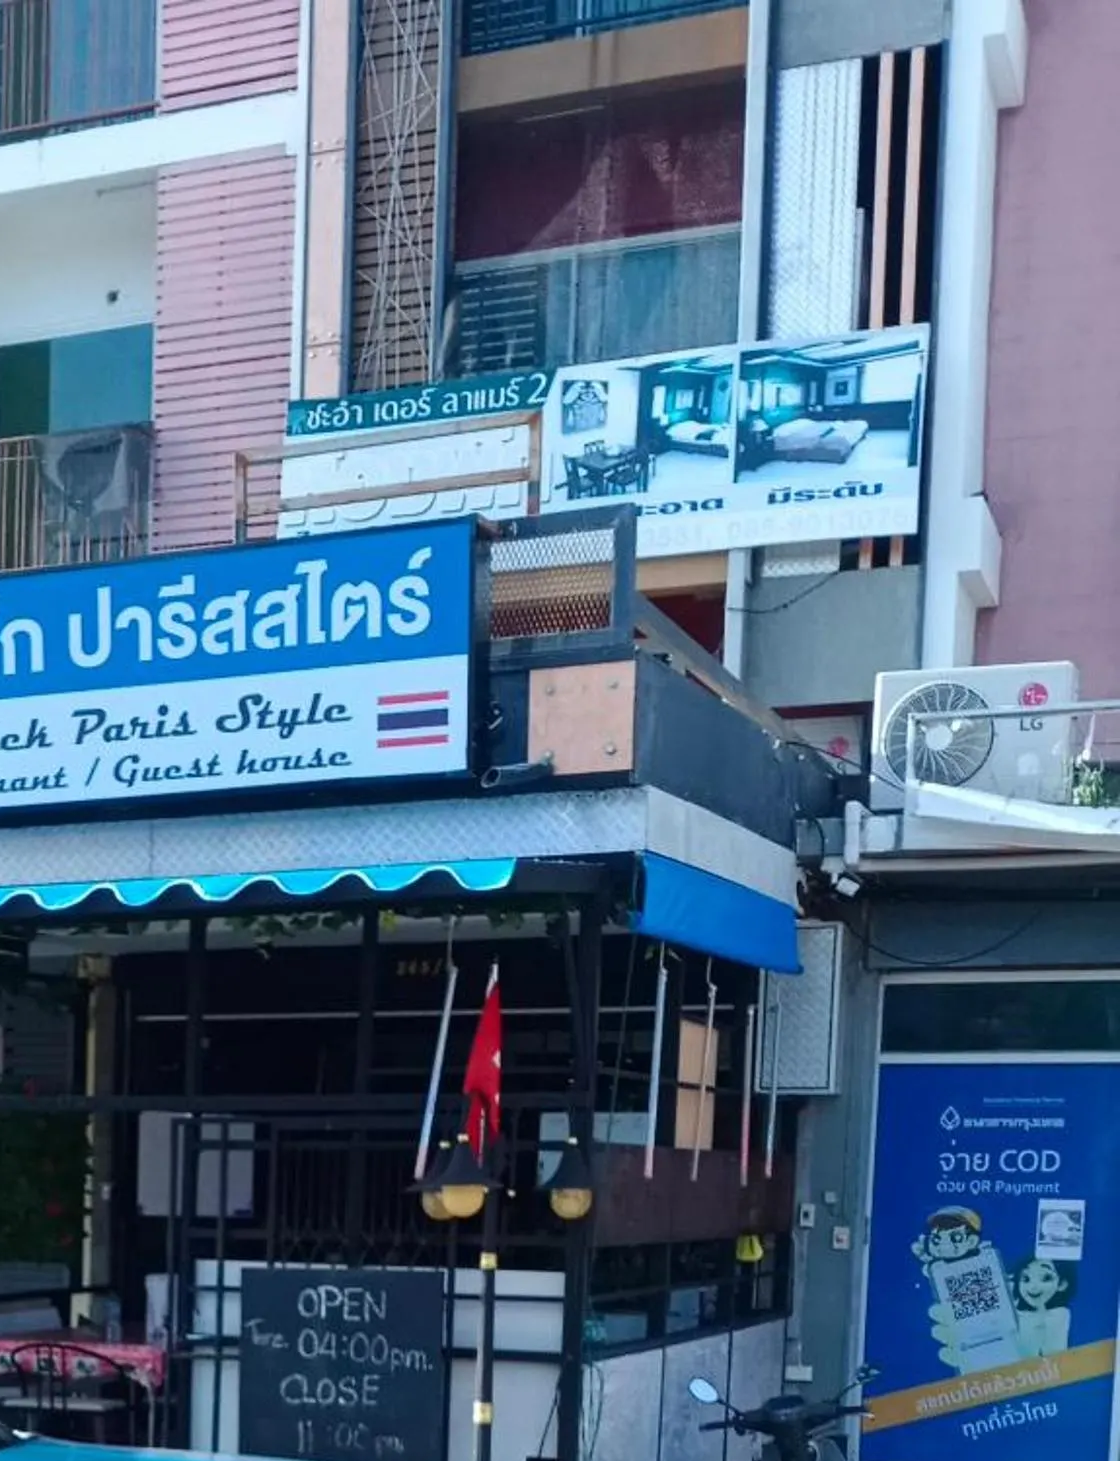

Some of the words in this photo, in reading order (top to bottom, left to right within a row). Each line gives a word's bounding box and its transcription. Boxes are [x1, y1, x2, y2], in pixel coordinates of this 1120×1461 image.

[305, 400, 363, 429] ชะอำ
[373, 387, 438, 421] เดอร์
[441, 376, 525, 414] ลาแมร์
[527, 372, 548, 405] 2
[67, 546, 434, 668] ปารีสสไตร์
[71, 704, 198, 748] Paris
[214, 692, 353, 744] Style
[1019, 716, 1045, 732] LG
[85, 757, 100, 787] /
[113, 750, 223, 786] Guest
[236, 746, 353, 775] house
[938, 1138, 991, 1173] จ่าย
[999, 1148, 1061, 1173] COD
[969, 1179, 992, 1196] QR
[994, 1179, 1061, 1197] Payment
[297, 1284, 388, 1323] OPEN
[280, 1372, 383, 1406] CLOSE
[961, 1401, 1059, 1441] ทุกที่ทั่วไทย
